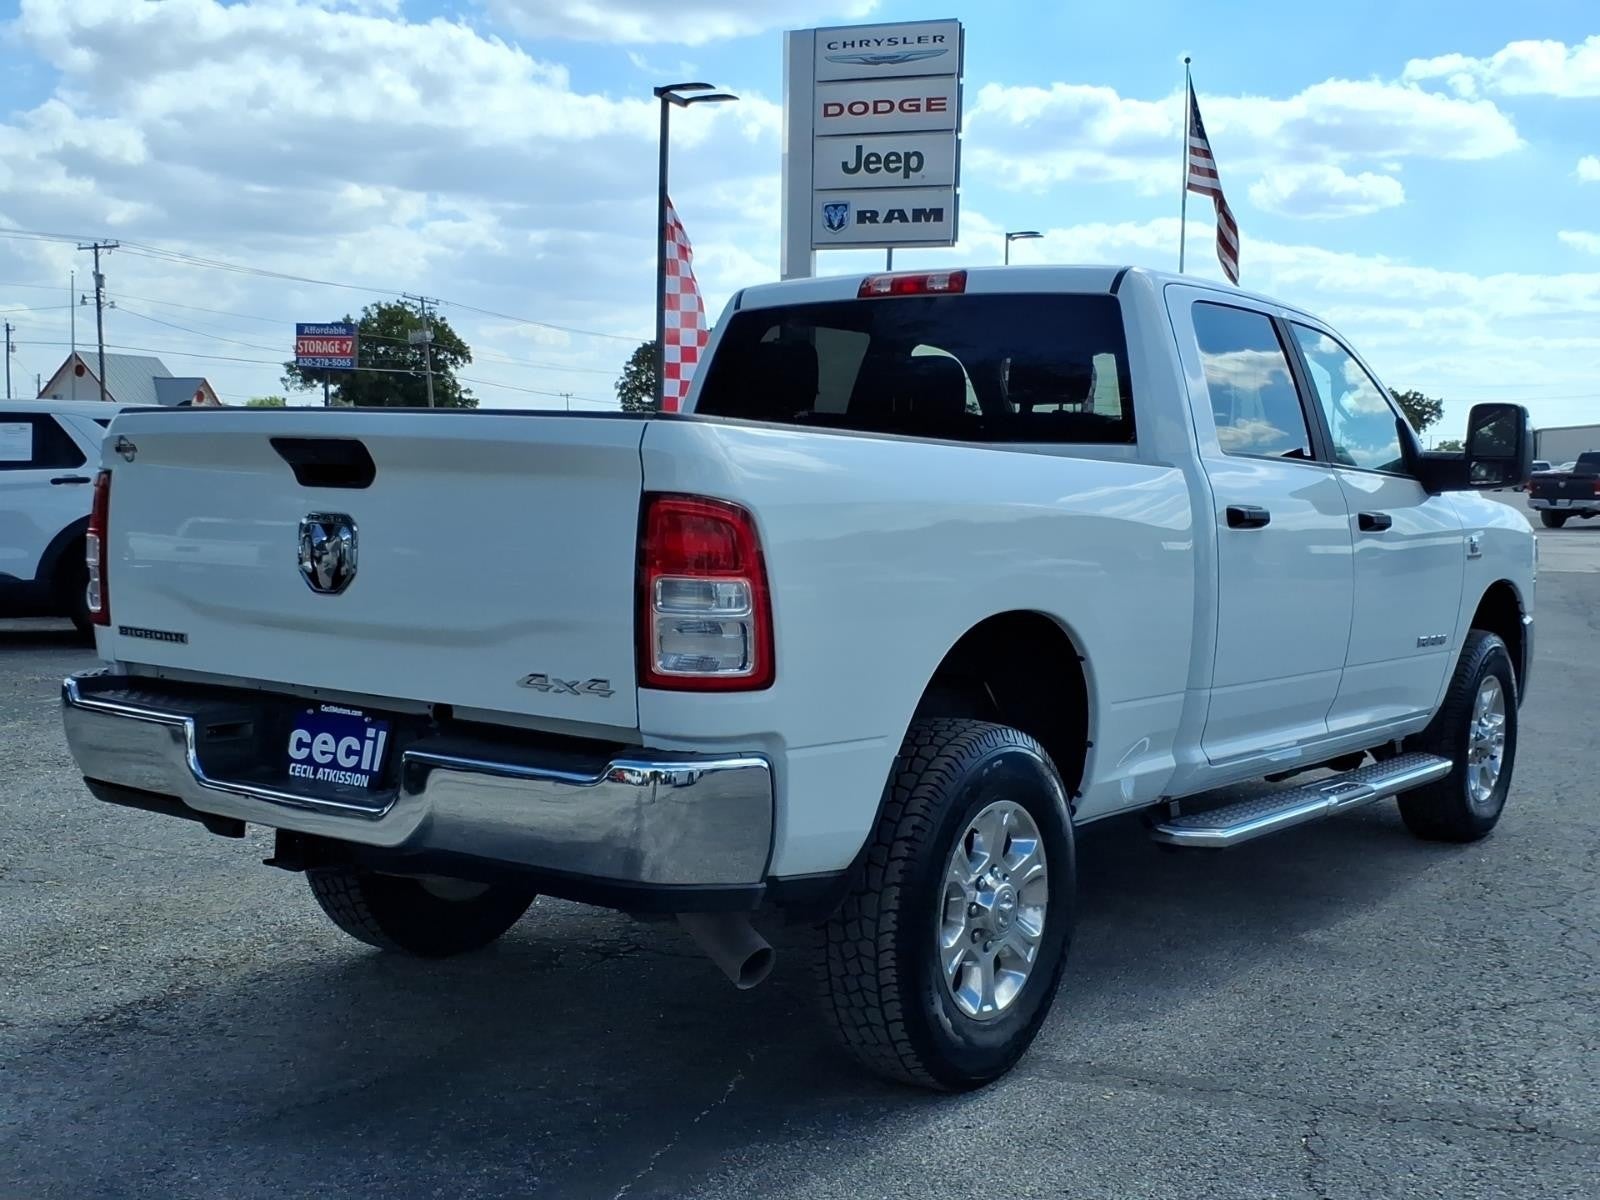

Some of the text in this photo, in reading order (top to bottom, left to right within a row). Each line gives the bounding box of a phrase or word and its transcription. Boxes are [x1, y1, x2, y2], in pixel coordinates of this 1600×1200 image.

[827, 34, 945, 50] CHRYSLER
[823, 97, 947, 118] DODGE
[841, 144, 925, 179] Jeep
[856, 207, 944, 224] RAM
[304, 325, 347, 335] Affordable
[298, 340, 340, 353] STORAGE
[288, 727, 387, 772] cecil
[289, 763, 370, 788] CECIL ATKISSION
